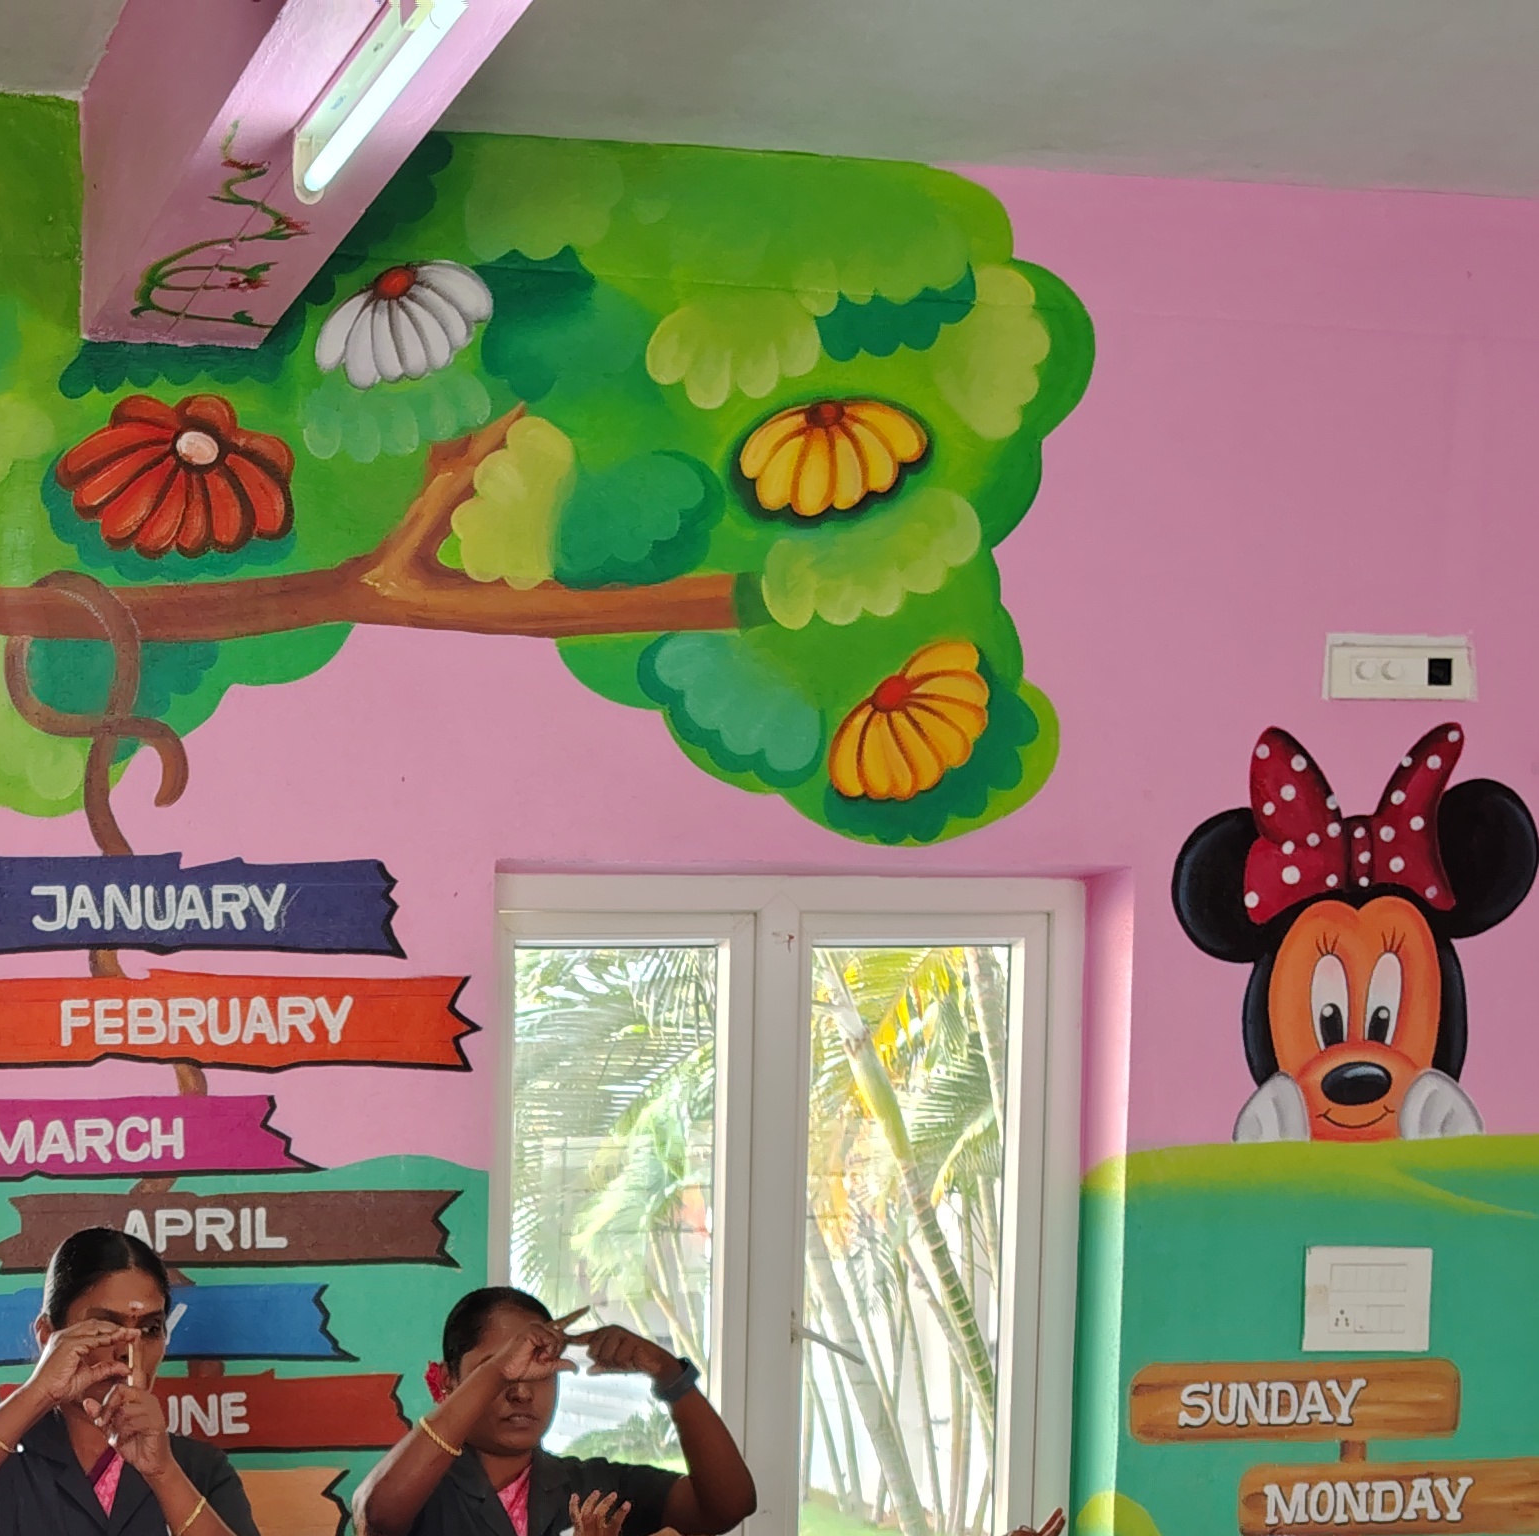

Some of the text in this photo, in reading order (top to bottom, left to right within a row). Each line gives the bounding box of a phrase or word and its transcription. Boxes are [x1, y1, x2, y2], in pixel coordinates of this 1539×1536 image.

[30, 882, 287, 932] JANUARY
[60, 995, 353, 1047] FEBRUARY
[124, 1207, 288, 1253] APRIL
[1178, 1378, 1367, 1427] SUNDAY
[1263, 1477, 1473, 1525] MONDAY
